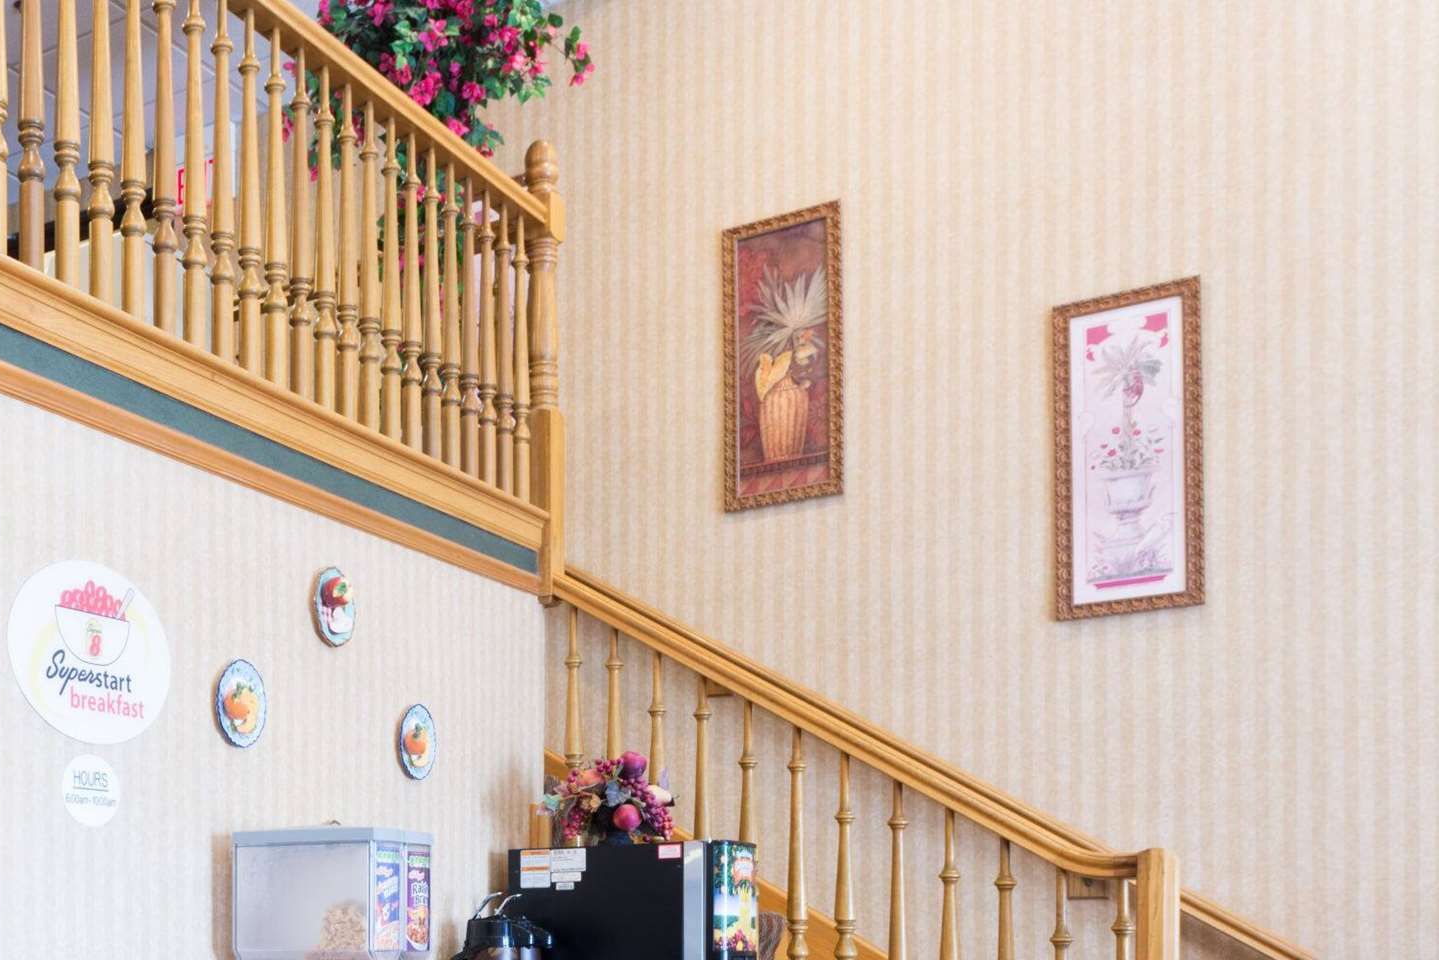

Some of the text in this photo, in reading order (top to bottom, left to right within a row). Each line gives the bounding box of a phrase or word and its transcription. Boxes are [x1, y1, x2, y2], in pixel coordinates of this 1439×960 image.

[46, 649, 132, 696] Superstart
[69, 685, 145, 719] breakfast
[72, 769, 109, 788] HOURS
